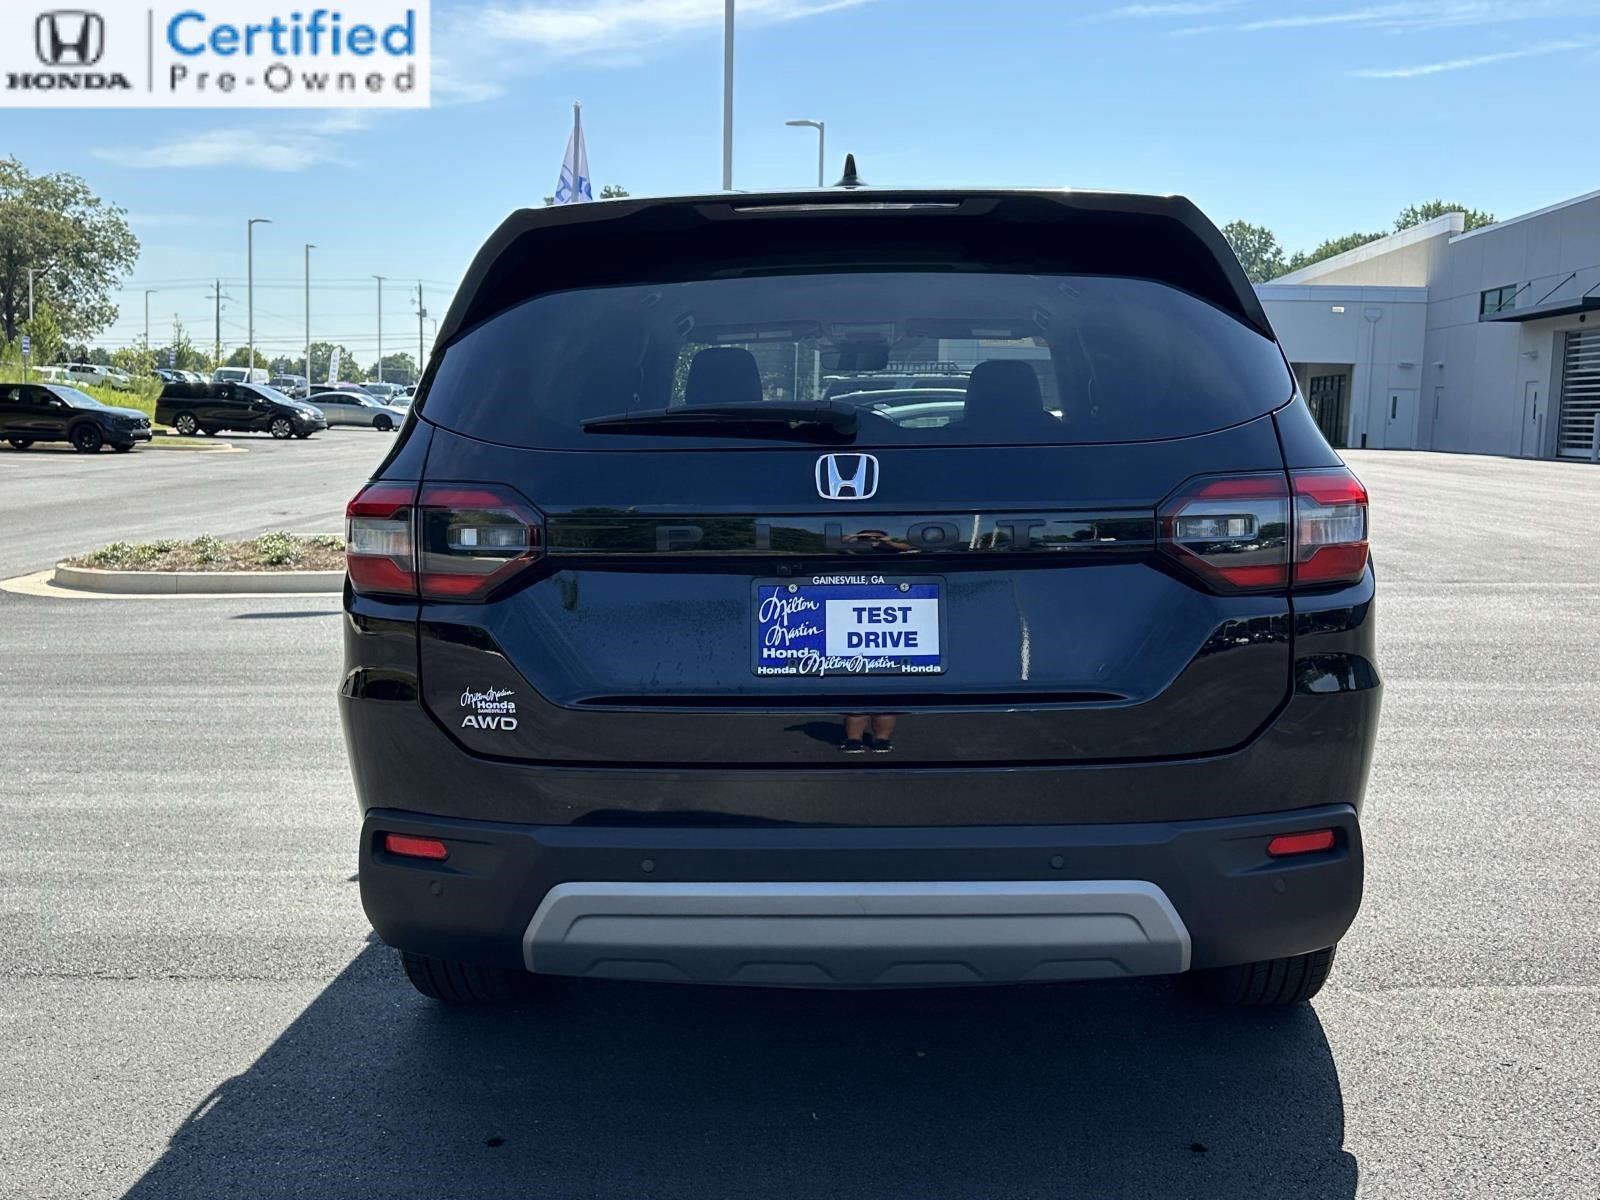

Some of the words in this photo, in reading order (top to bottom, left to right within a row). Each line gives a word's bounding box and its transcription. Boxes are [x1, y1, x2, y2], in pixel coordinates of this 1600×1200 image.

[655, 518, 1047, 552] PILOT
[812, 576, 869, 585] GAINESVILLE,
[871, 576, 885, 584] GA
[758, 587, 820, 625] Milton
[852, 606, 912, 624] TEST
[765, 618, 824, 646] Martin
[847, 631, 918, 649] DRIVE
[762, 647, 820, 659] Honda
[757, 665, 797, 674] Honda
[799, 653, 848, 676] Milton
[847, 653, 901, 673] Martin
[902, 664, 941, 673] Honda
[477, 701, 515, 709] Honda
[461, 715, 518, 730] AWD
